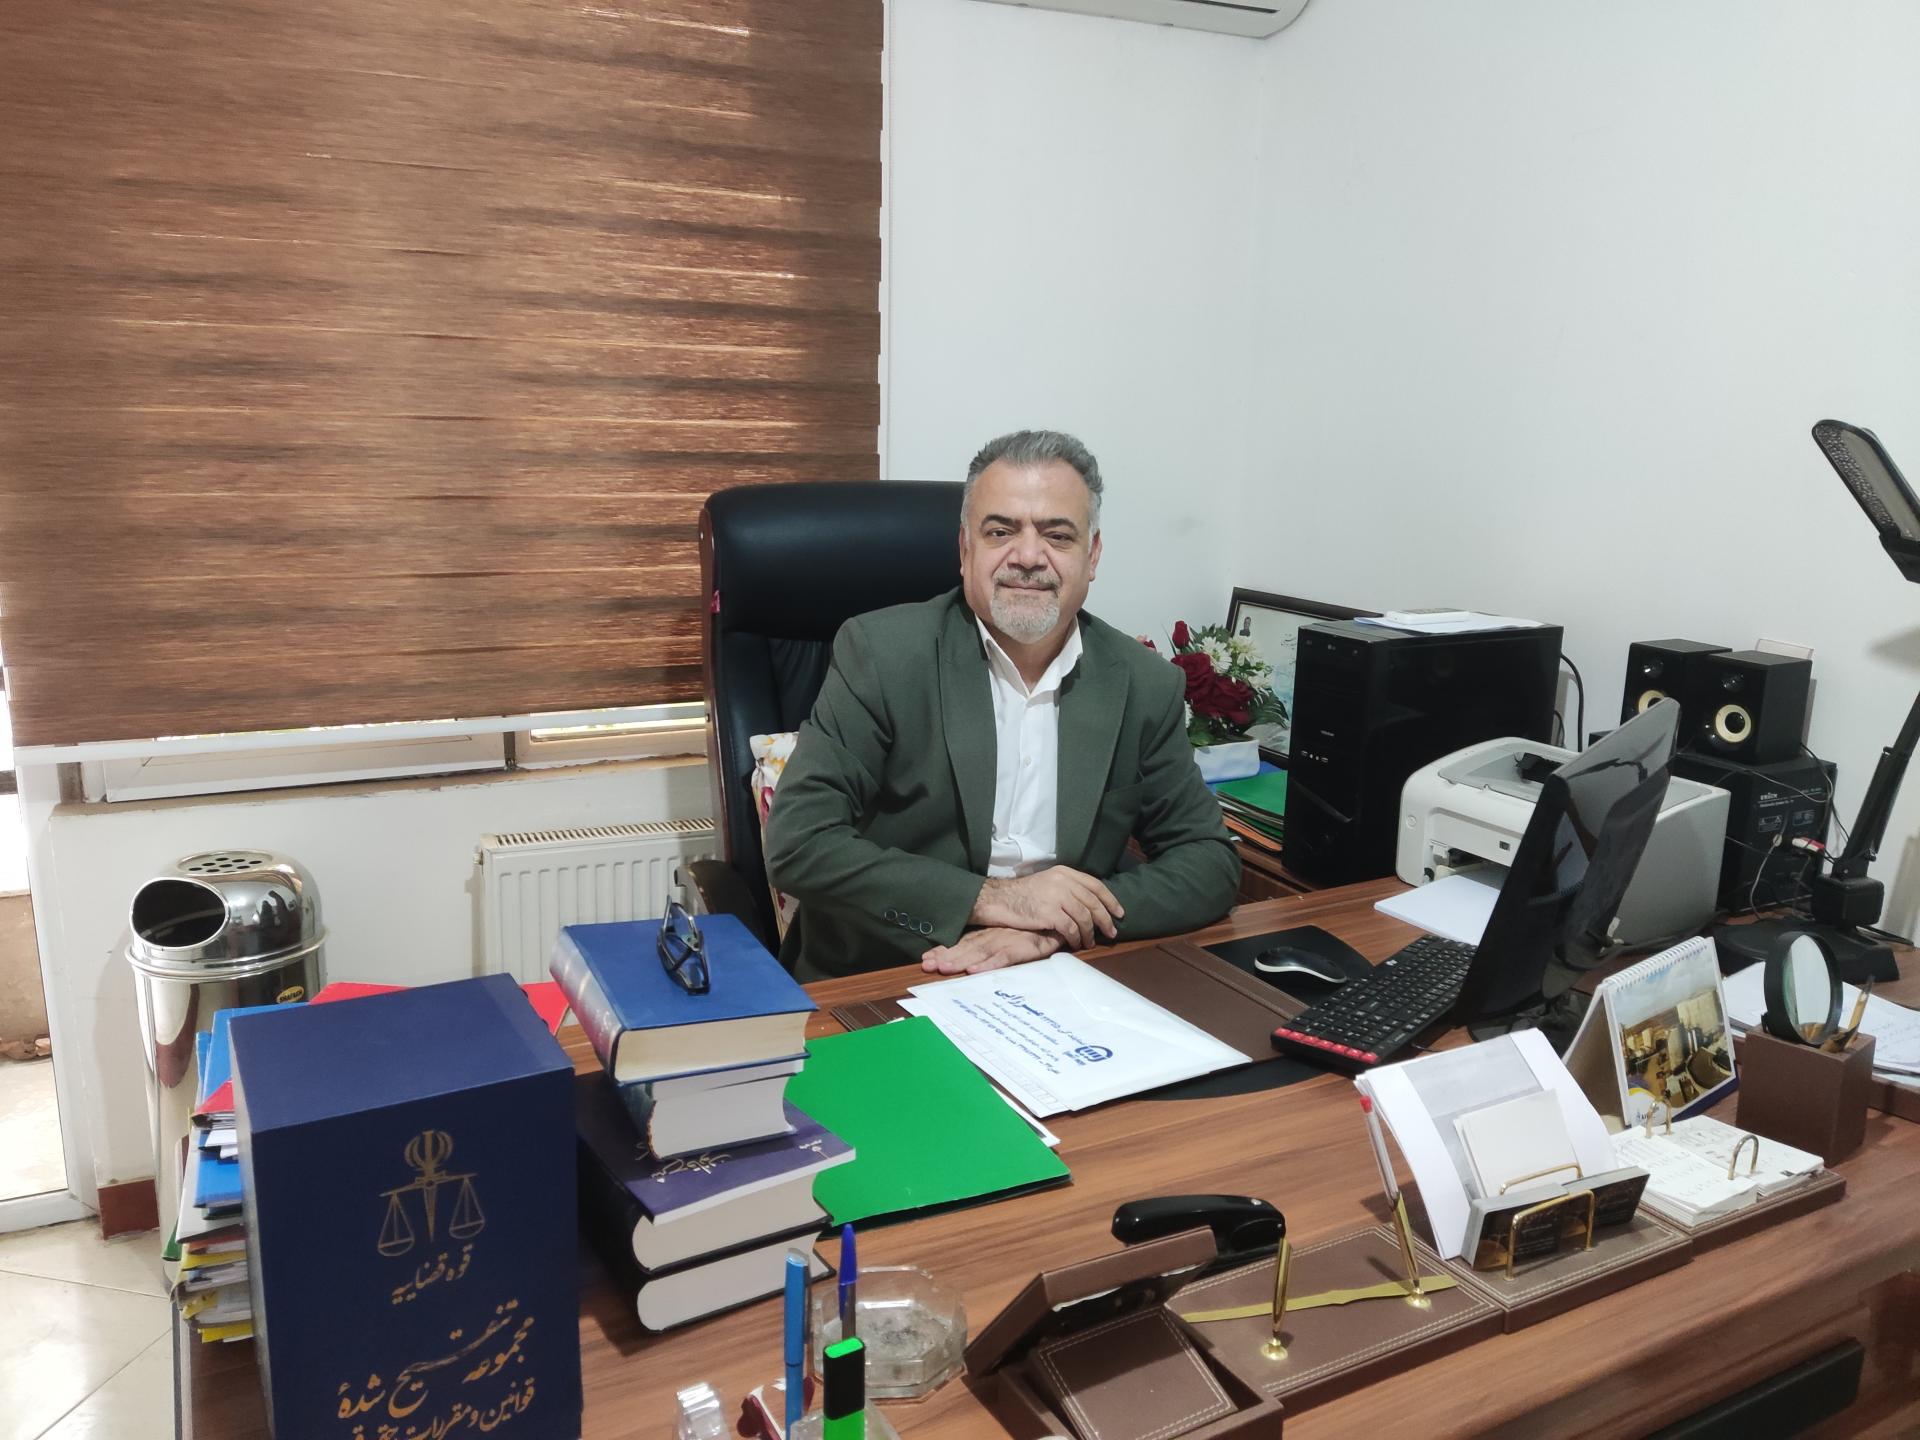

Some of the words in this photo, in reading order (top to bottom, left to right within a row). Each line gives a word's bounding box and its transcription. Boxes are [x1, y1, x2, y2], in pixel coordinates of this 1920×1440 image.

[994, 989, 1044, 1016] میرزایی
[686, 1152, 733, 1175] قانون
[446, 1243, 473, 1282] قوه
[462, 1316, 535, 1384] مجموعه
[467, 1409, 479, 1428] و
[479, 1377, 535, 1432] قوانین
